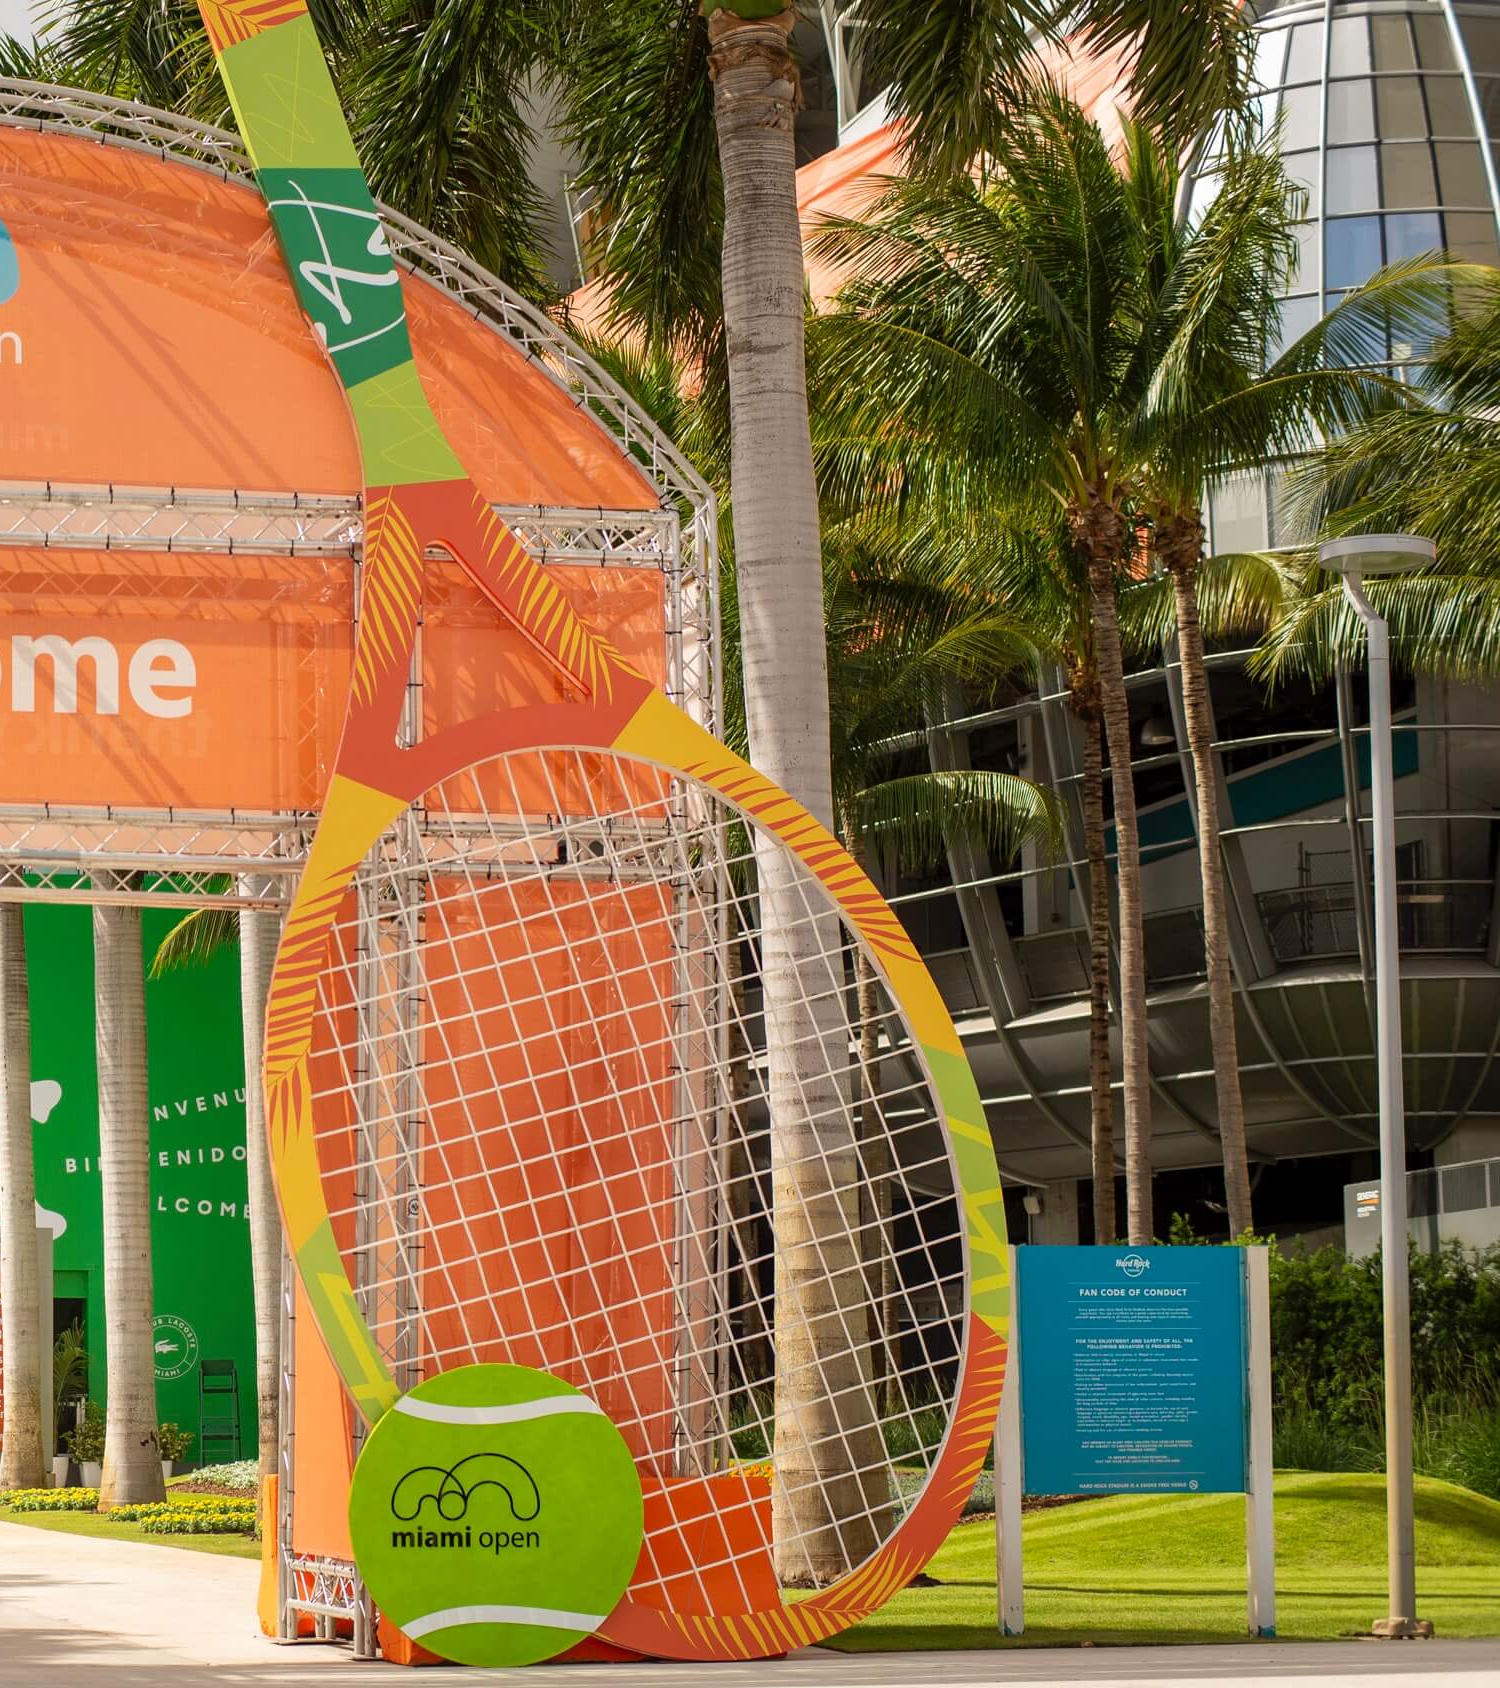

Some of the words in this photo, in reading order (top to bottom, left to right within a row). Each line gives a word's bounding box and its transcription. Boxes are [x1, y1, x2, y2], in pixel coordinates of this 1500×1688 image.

[153, 1087, 246, 1122] NVENU
[157, 1196, 251, 1220] LCOME
[1079, 1288, 1098, 1297] FAN
[1100, 1288, 1125, 1297] CODE
[1128, 1288, 1141, 1297] OF
[1143, 1288, 1188, 1297] CONDUCT
[392, 1525, 472, 1548] miami
[478, 1531, 540, 1556] open
